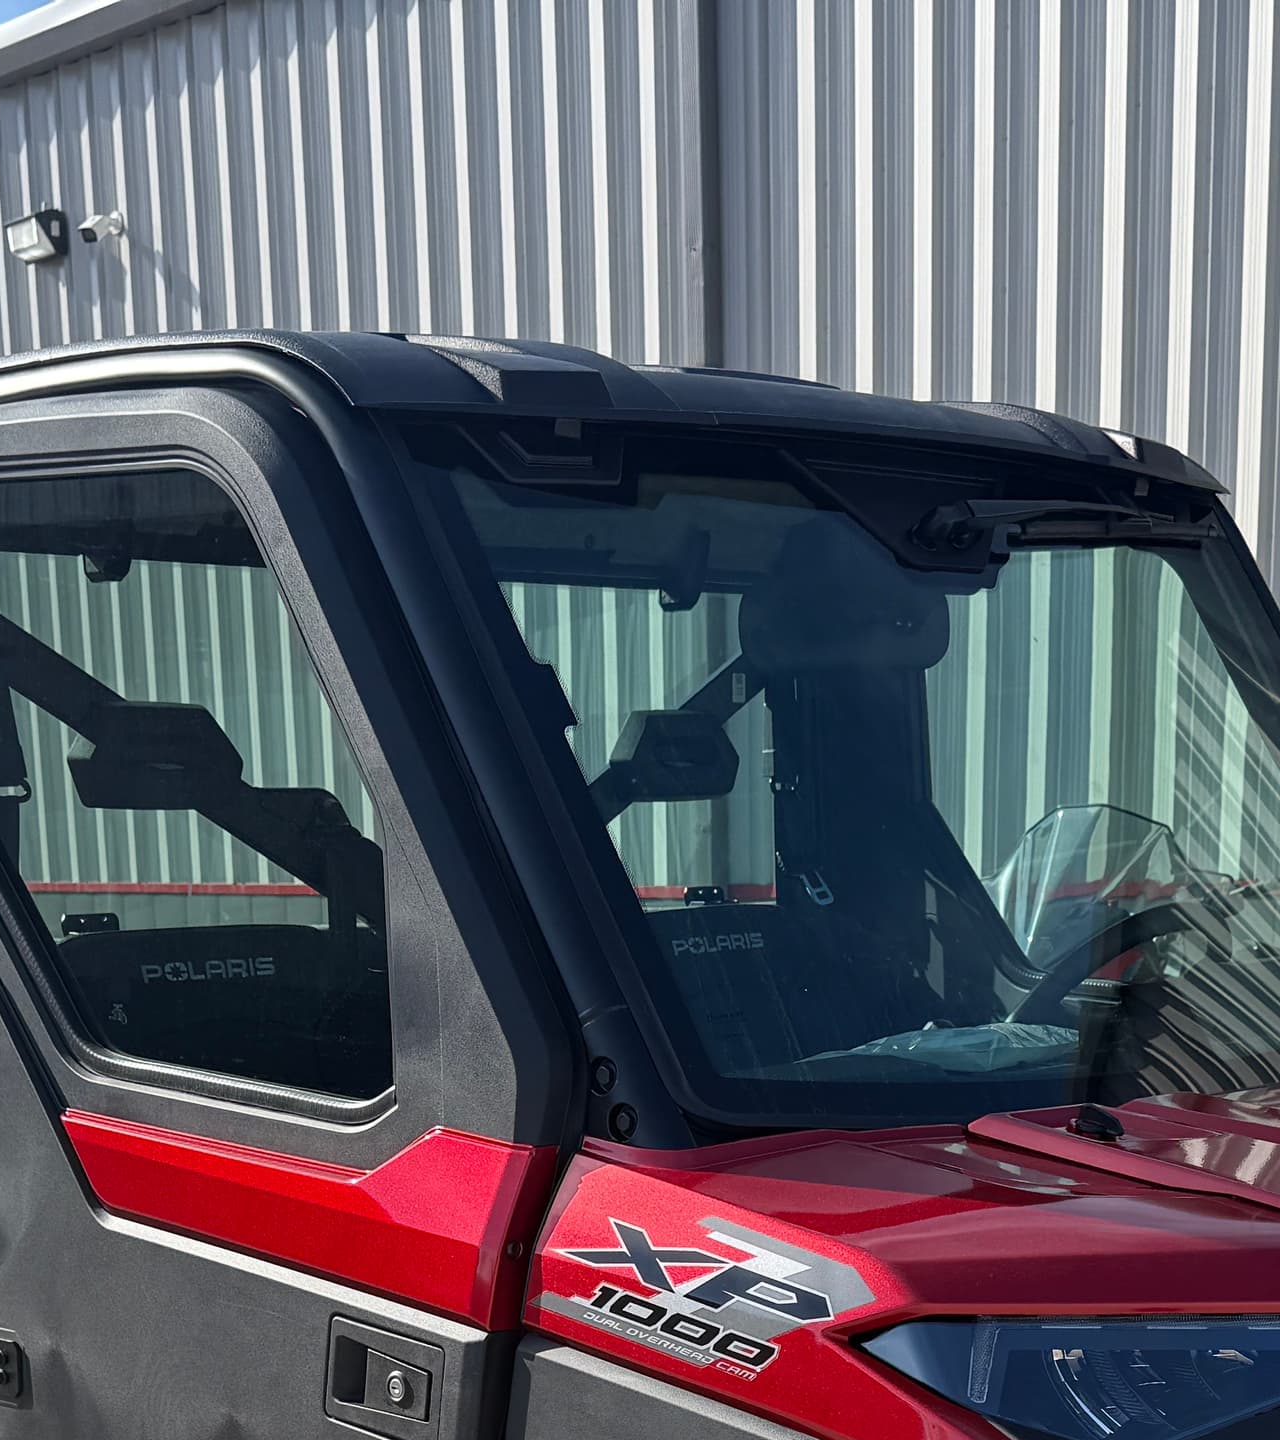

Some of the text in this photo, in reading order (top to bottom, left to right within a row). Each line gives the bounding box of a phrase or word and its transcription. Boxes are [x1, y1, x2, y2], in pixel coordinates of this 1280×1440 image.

[140, 957, 276, 984] POLARIS
[672, 932, 764, 957] POLARIS
[551, 1216, 834, 1323] XP
[583, 1311, 757, 1382] DUAL OVERHEAD CAM
[589, 1282, 780, 1370] 1000
